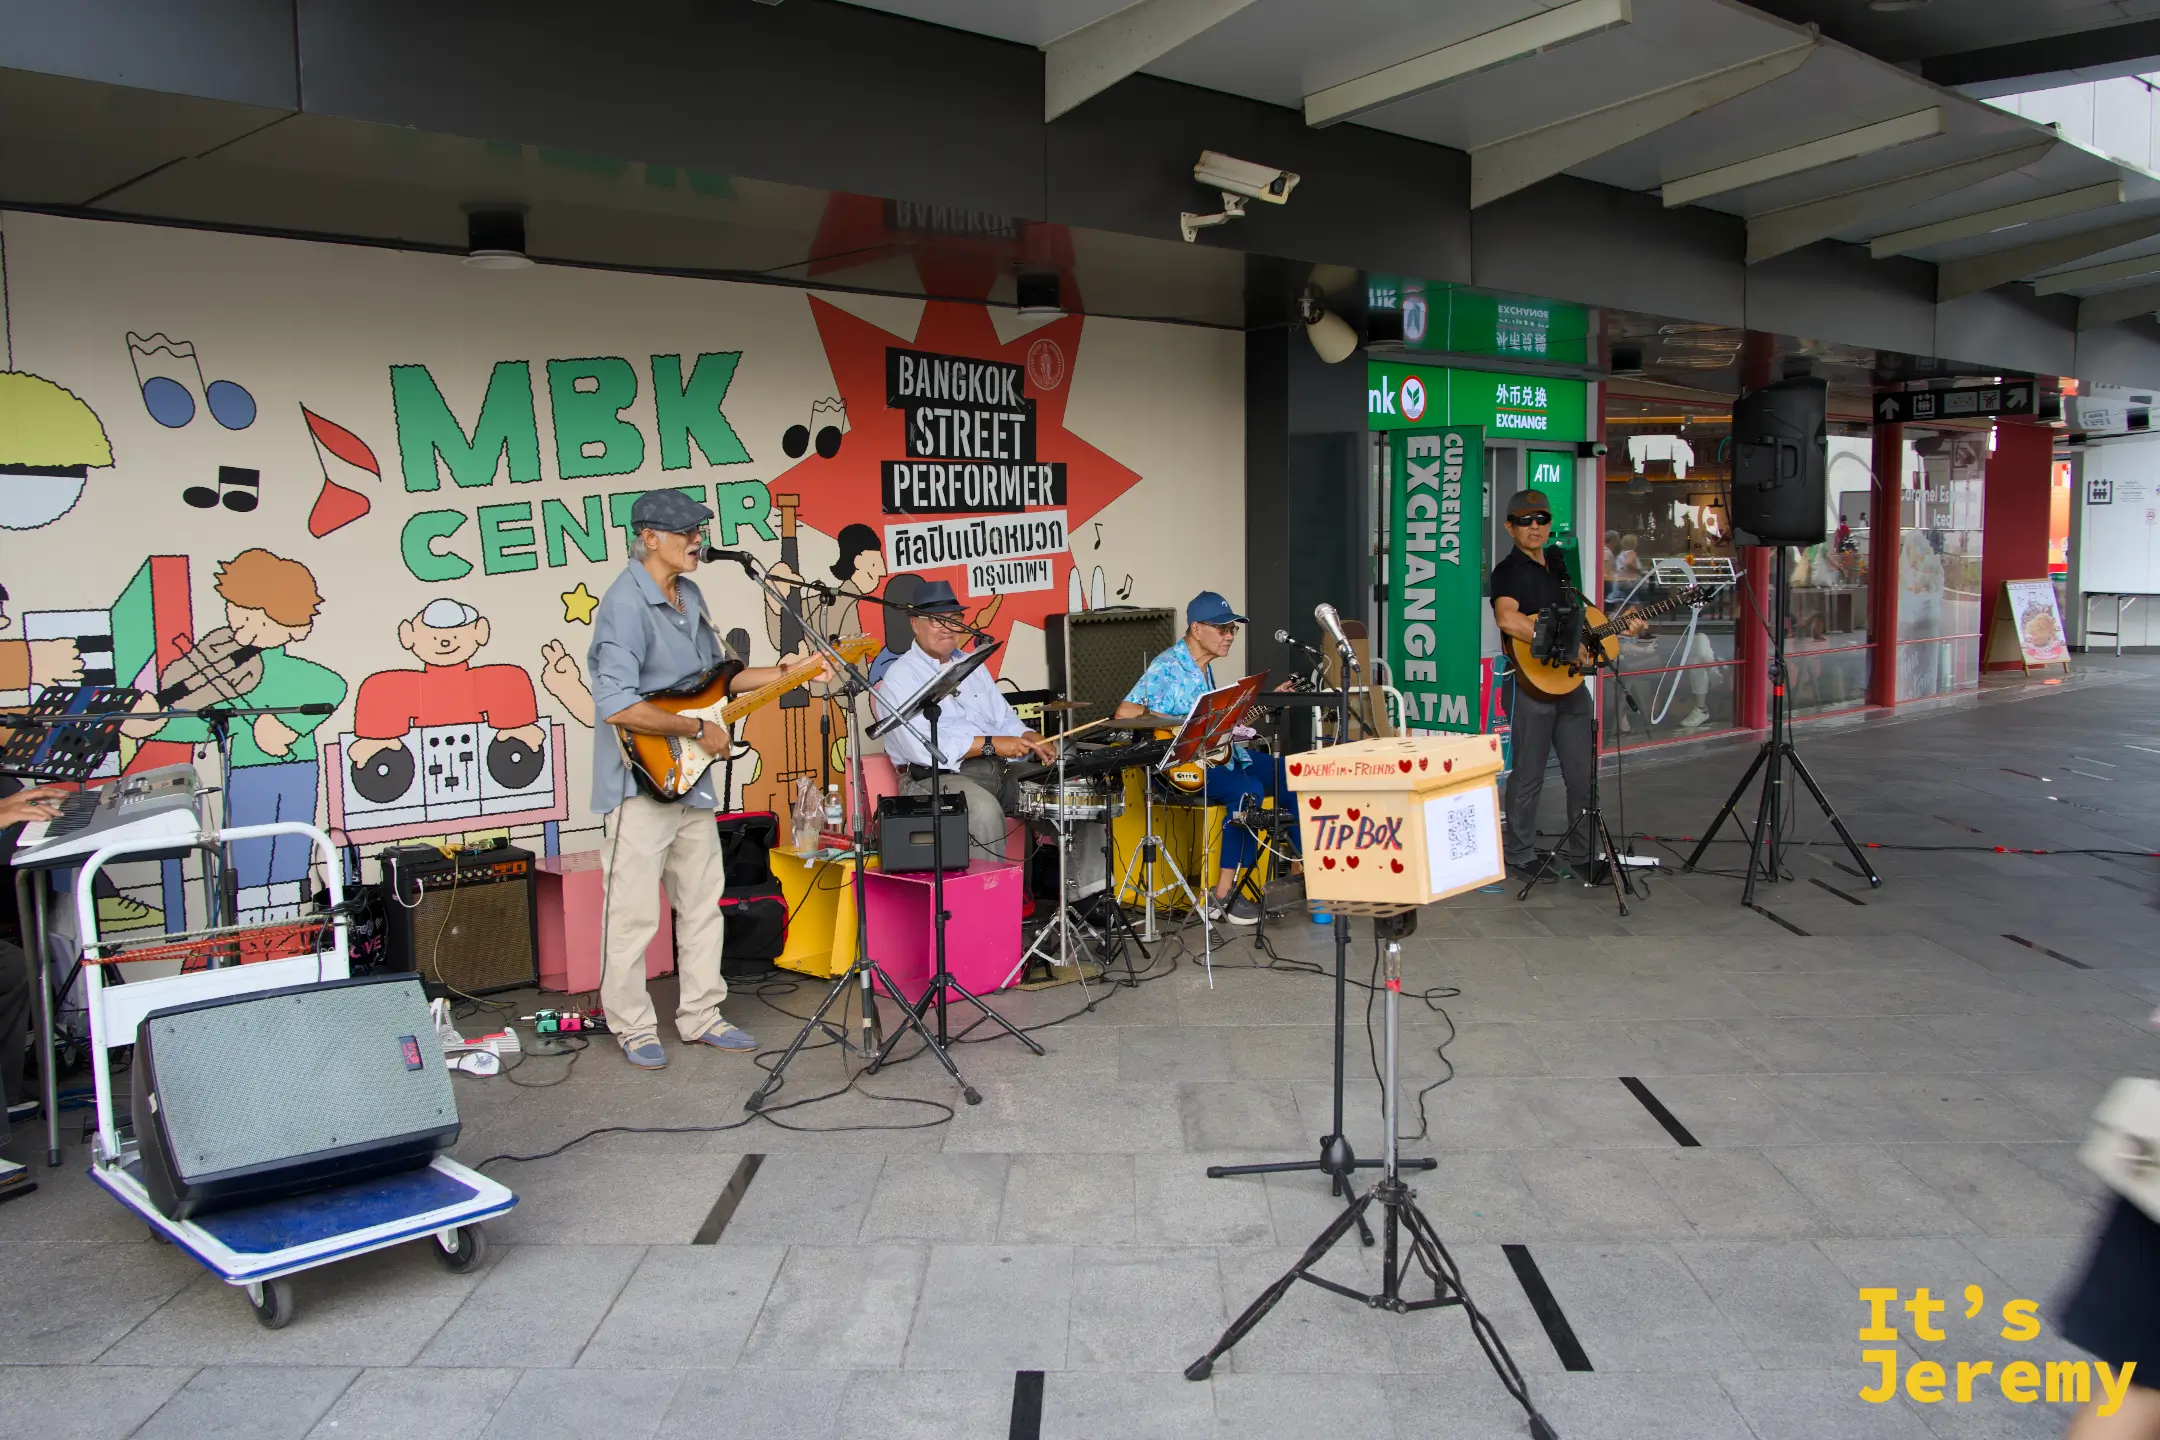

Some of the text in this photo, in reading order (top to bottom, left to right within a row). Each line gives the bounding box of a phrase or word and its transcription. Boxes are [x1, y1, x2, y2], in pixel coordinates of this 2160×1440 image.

[898, 355, 1018, 407] BANGKOK
[1496, 384, 1548, 408] 外币兑换
[389, 351, 754, 492] MBK
[915, 407, 1026, 460] STREET
[1496, 413, 1548, 430] EXCHANGE
[892, 463, 1055, 508] PERFORMER
[1533, 463, 1560, 483] ATM
[1439, 432, 1464, 567] CURRENCY
[895, 519, 1063, 567] ศิลปินเปิดหมวก
[1403, 435, 1441, 683] EXCHANGE
[972, 564, 1048, 596] กรุงเทพฯ
[1401, 692, 1469, 726] ATM
